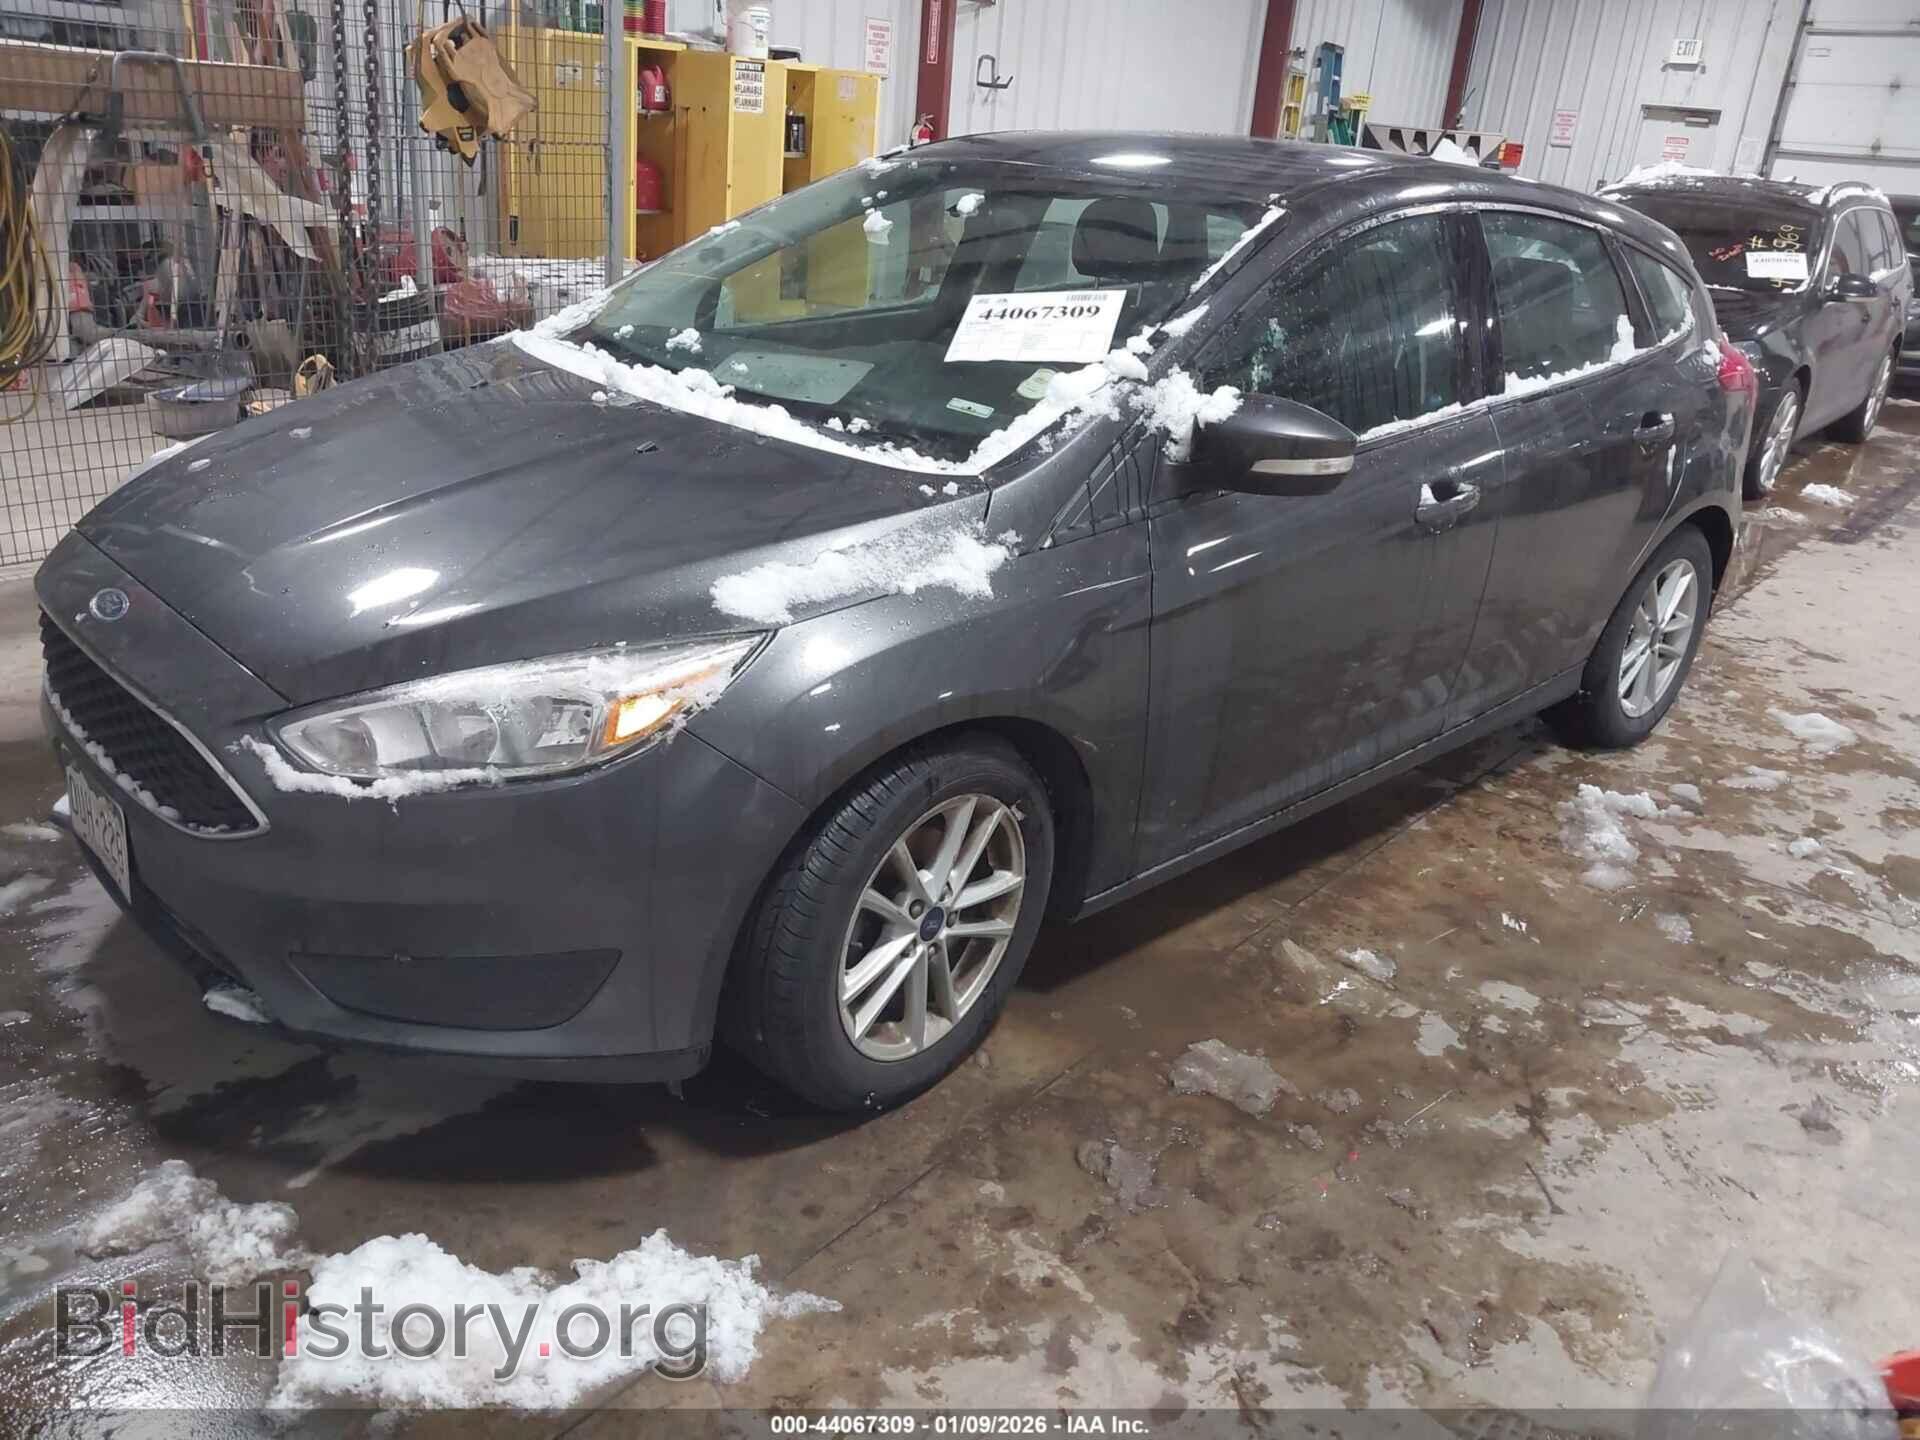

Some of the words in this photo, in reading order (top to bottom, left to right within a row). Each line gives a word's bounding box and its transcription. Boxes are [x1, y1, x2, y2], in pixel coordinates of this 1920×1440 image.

[1676, 40, 1698, 57] EXIT
[735, 71, 762, 82] LAMMABLE
[978, 305, 1101, 320] 44067309
